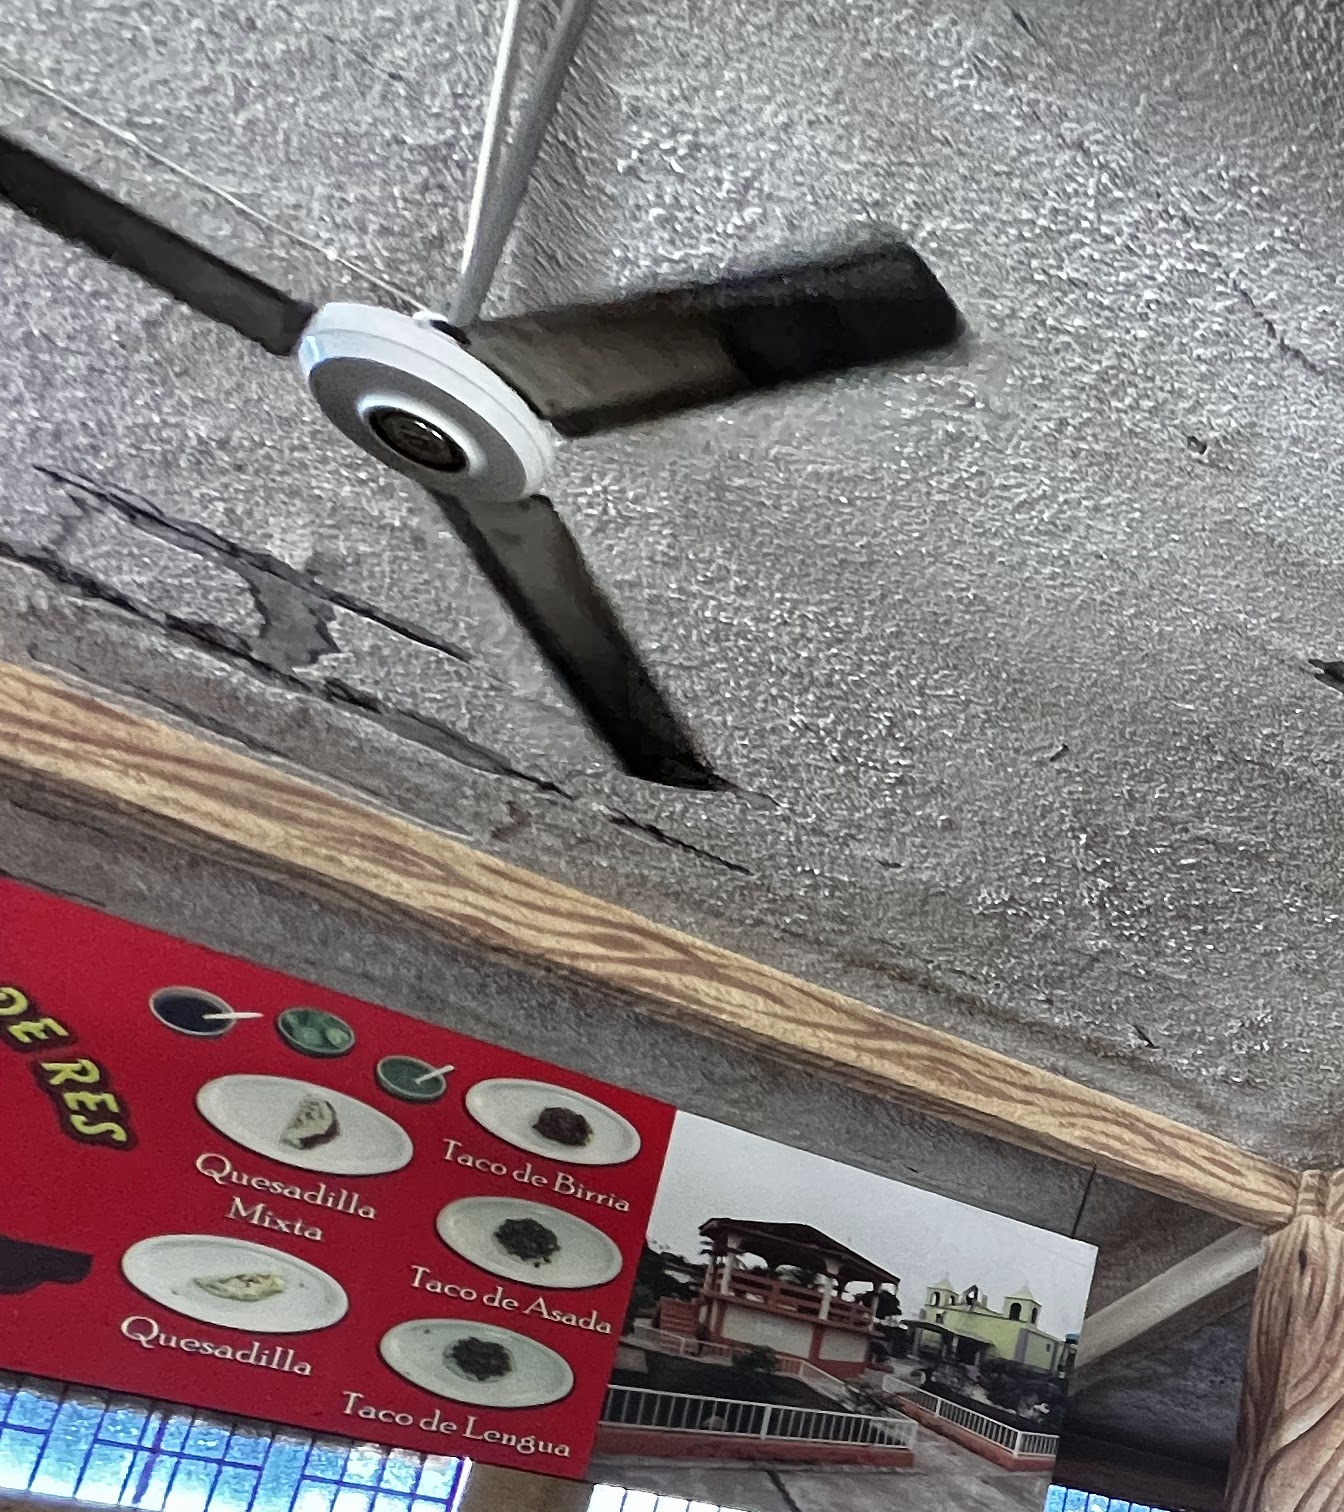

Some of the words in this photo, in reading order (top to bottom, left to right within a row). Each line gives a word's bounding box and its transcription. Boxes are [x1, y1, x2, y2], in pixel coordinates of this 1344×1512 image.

[40, 1057, 129, 1142] RES
[195, 1153, 377, 1220] Quesadilla
[442, 1138, 508, 1179] Taco
[513, 1161, 549, 1188] de
[555, 1173, 632, 1214] Birria
[226, 1197, 324, 1242] Mixta
[410, 1265, 482, 1304] Taco
[486, 1283, 519, 1313] de
[524, 1295, 612, 1336] Asada
[120, 1316, 313, 1378] Quesadilla
[342, 1390, 412, 1429] Taco
[418, 1409, 458, 1437] de
[463, 1417, 571, 1461] Lengua
